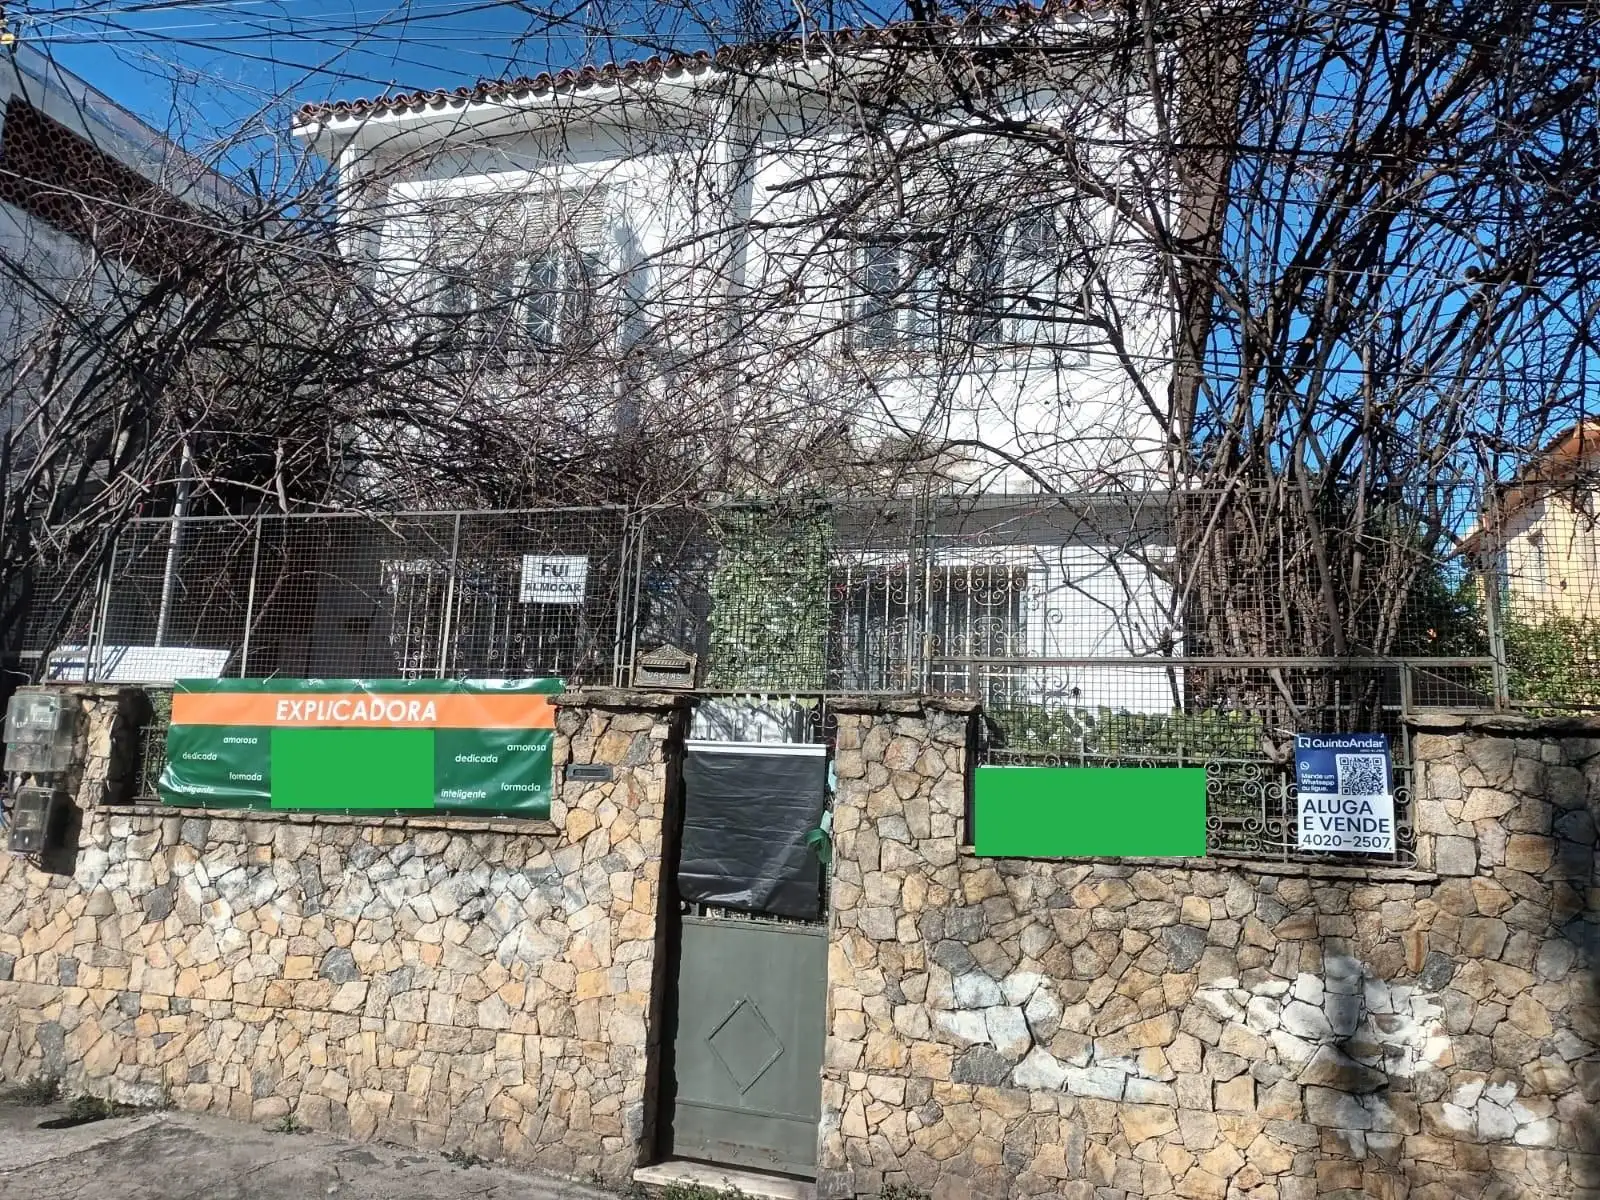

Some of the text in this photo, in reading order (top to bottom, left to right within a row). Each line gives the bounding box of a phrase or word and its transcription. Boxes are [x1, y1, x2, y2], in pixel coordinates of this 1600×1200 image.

[541, 564, 569, 577] FUI
[276, 699, 437, 722] EXPLICADORA
[223, 736, 258, 744] amorosa
[1312, 738, 1384, 749] QuintoAndar
[506, 744, 547, 752] amorosa
[182, 752, 218, 761] dedicada
[455, 754, 498, 763] dedicada
[229, 772, 262, 781] formada
[501, 782, 541, 792] formada
[440, 789, 487, 800] inteligente
[1303, 799, 1373, 815] ALUGA
[1303, 816, 1391, 834] E VENDE
[1303, 834, 1391, 848] 4020-2507
